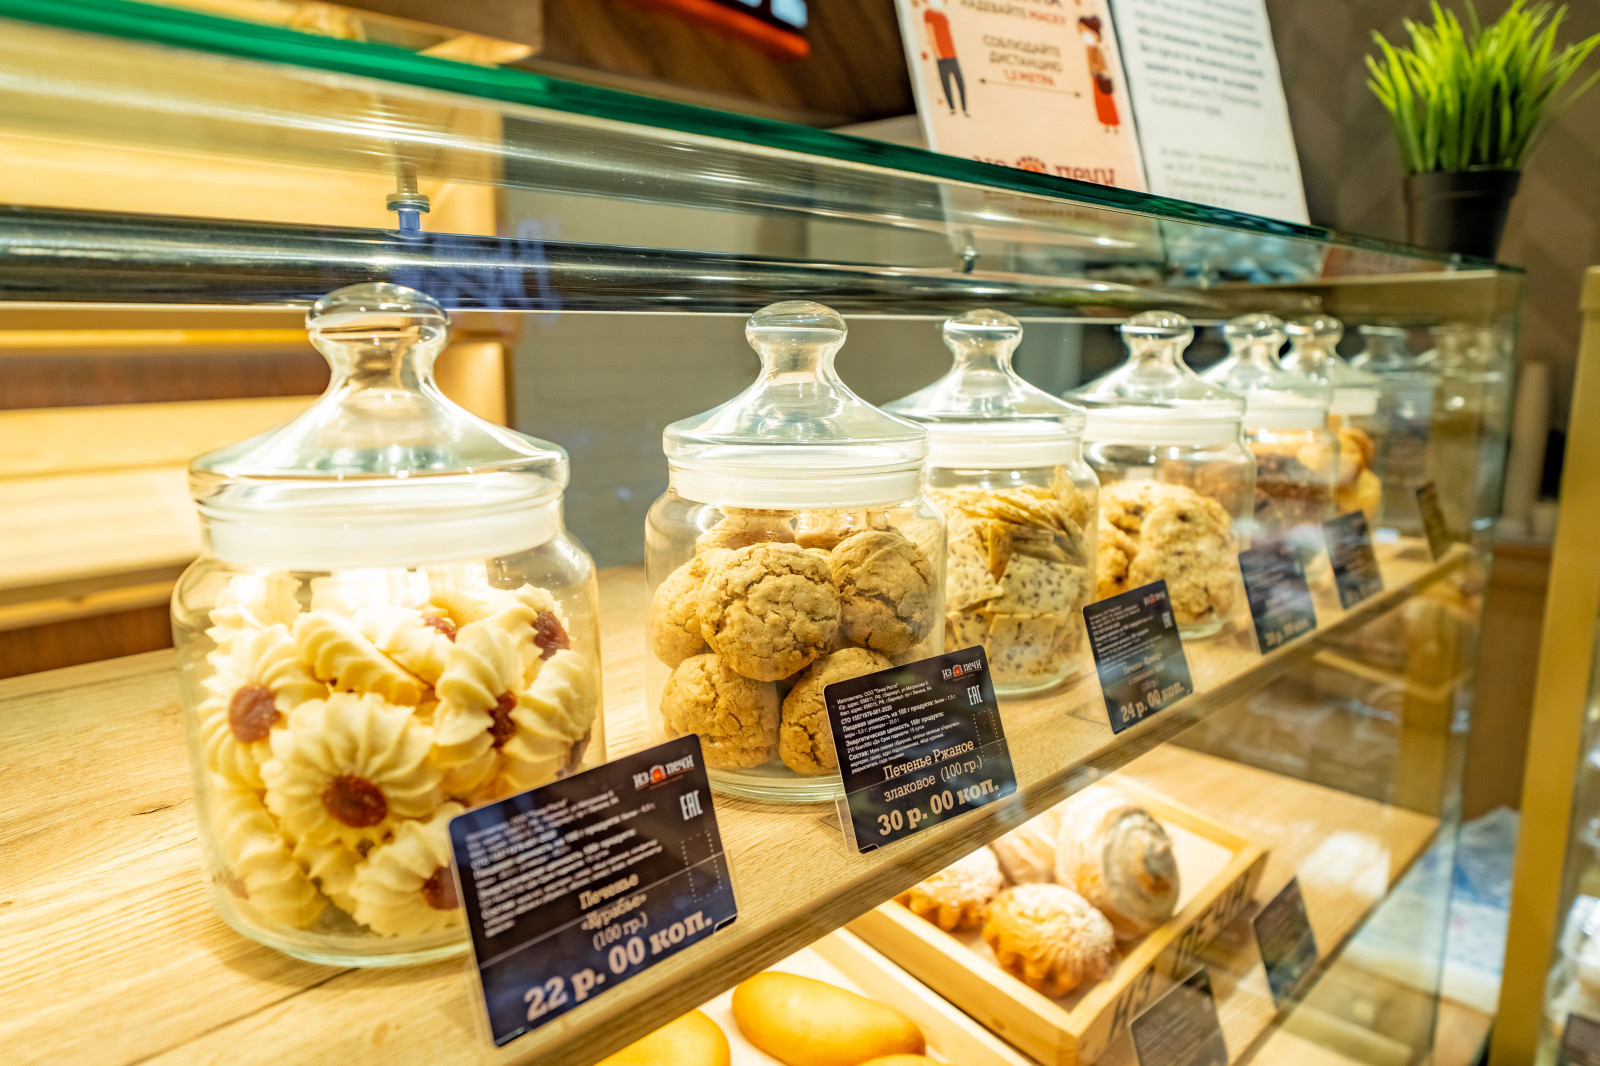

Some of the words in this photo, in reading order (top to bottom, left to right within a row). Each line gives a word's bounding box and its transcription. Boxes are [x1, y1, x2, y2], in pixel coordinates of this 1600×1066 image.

[983, 33, 1062, 57] СОБЛЮДАЙТЕ
[989, 50, 1064, 73] ДИСТАНЦИЮ
[962, 659, 981, 672] печи
[866, 714, 890, 725] ценность
[897, 707, 906, 715] 100
[910, 700, 933, 711] продукта:
[1120, 702, 1135, 722] 24
[1134, 701, 1147, 718] р.
[1147, 689, 1161, 707] 00
[1161, 682, 1183, 701] коп.
[840, 716, 851, 724] СТО
[845, 729, 886, 746] Энергетическая
[886, 722, 910, 733] ценность
[848, 750, 869, 760] Состав:
[883, 755, 931, 780] Печенье
[932, 740, 973, 762] Ржаное
[884, 775, 935, 801] злаковое
[940, 761, 962, 782] (100
[963, 755, 982, 773] гр.)
[877, 809, 903, 835] 30
[906, 807, 927, 829] р.
[929, 790, 953, 814] 00
[957, 779, 998, 804] коп.
[578, 873, 639, 910] Печенье
[591, 922, 622, 951] (100
[621, 910, 649, 935] гр.)
[524, 976, 568, 1020] 22
[570, 967, 605, 1001] р.
[607, 935, 645, 974] 00
[649, 910, 712, 954] коп.
